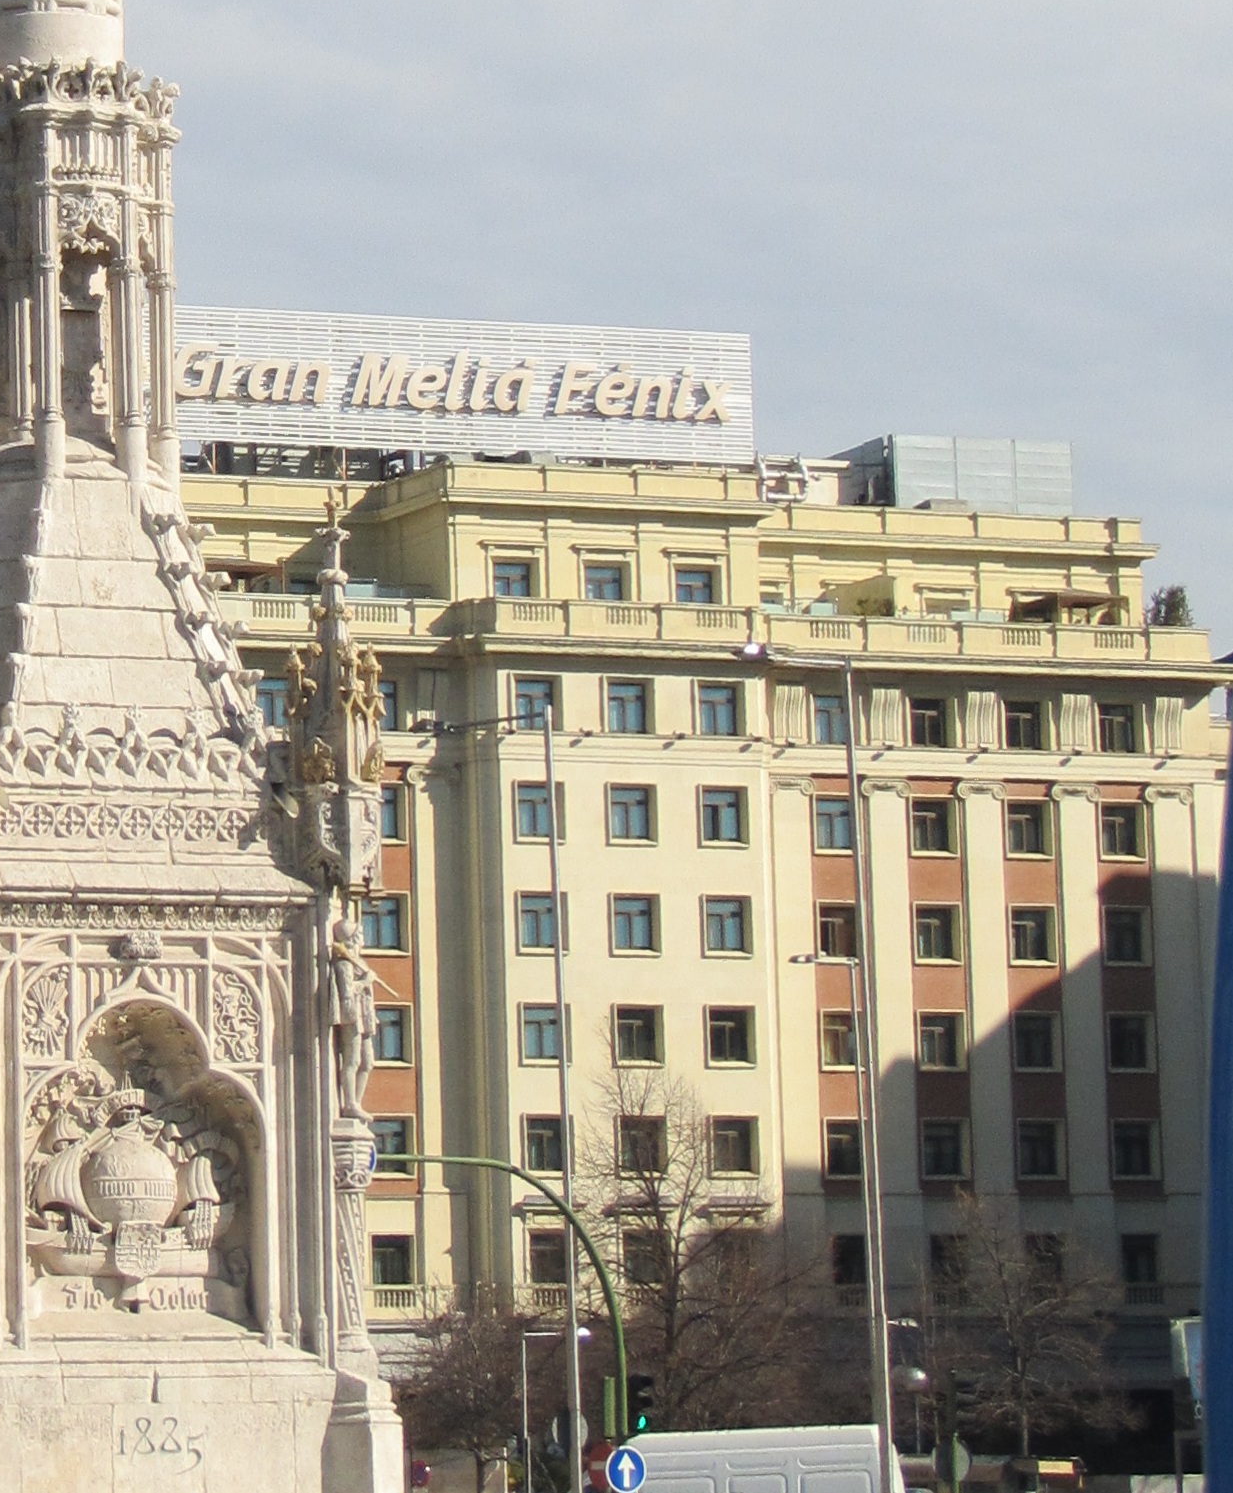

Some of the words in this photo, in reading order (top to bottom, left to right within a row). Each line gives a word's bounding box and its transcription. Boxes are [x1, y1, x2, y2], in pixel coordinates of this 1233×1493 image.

[174, 342, 330, 404] Gran
[350, 348, 538, 413] Meliá
[553, 361, 733, 422] Fénix
[116, 1416, 204, 1475] 1885
